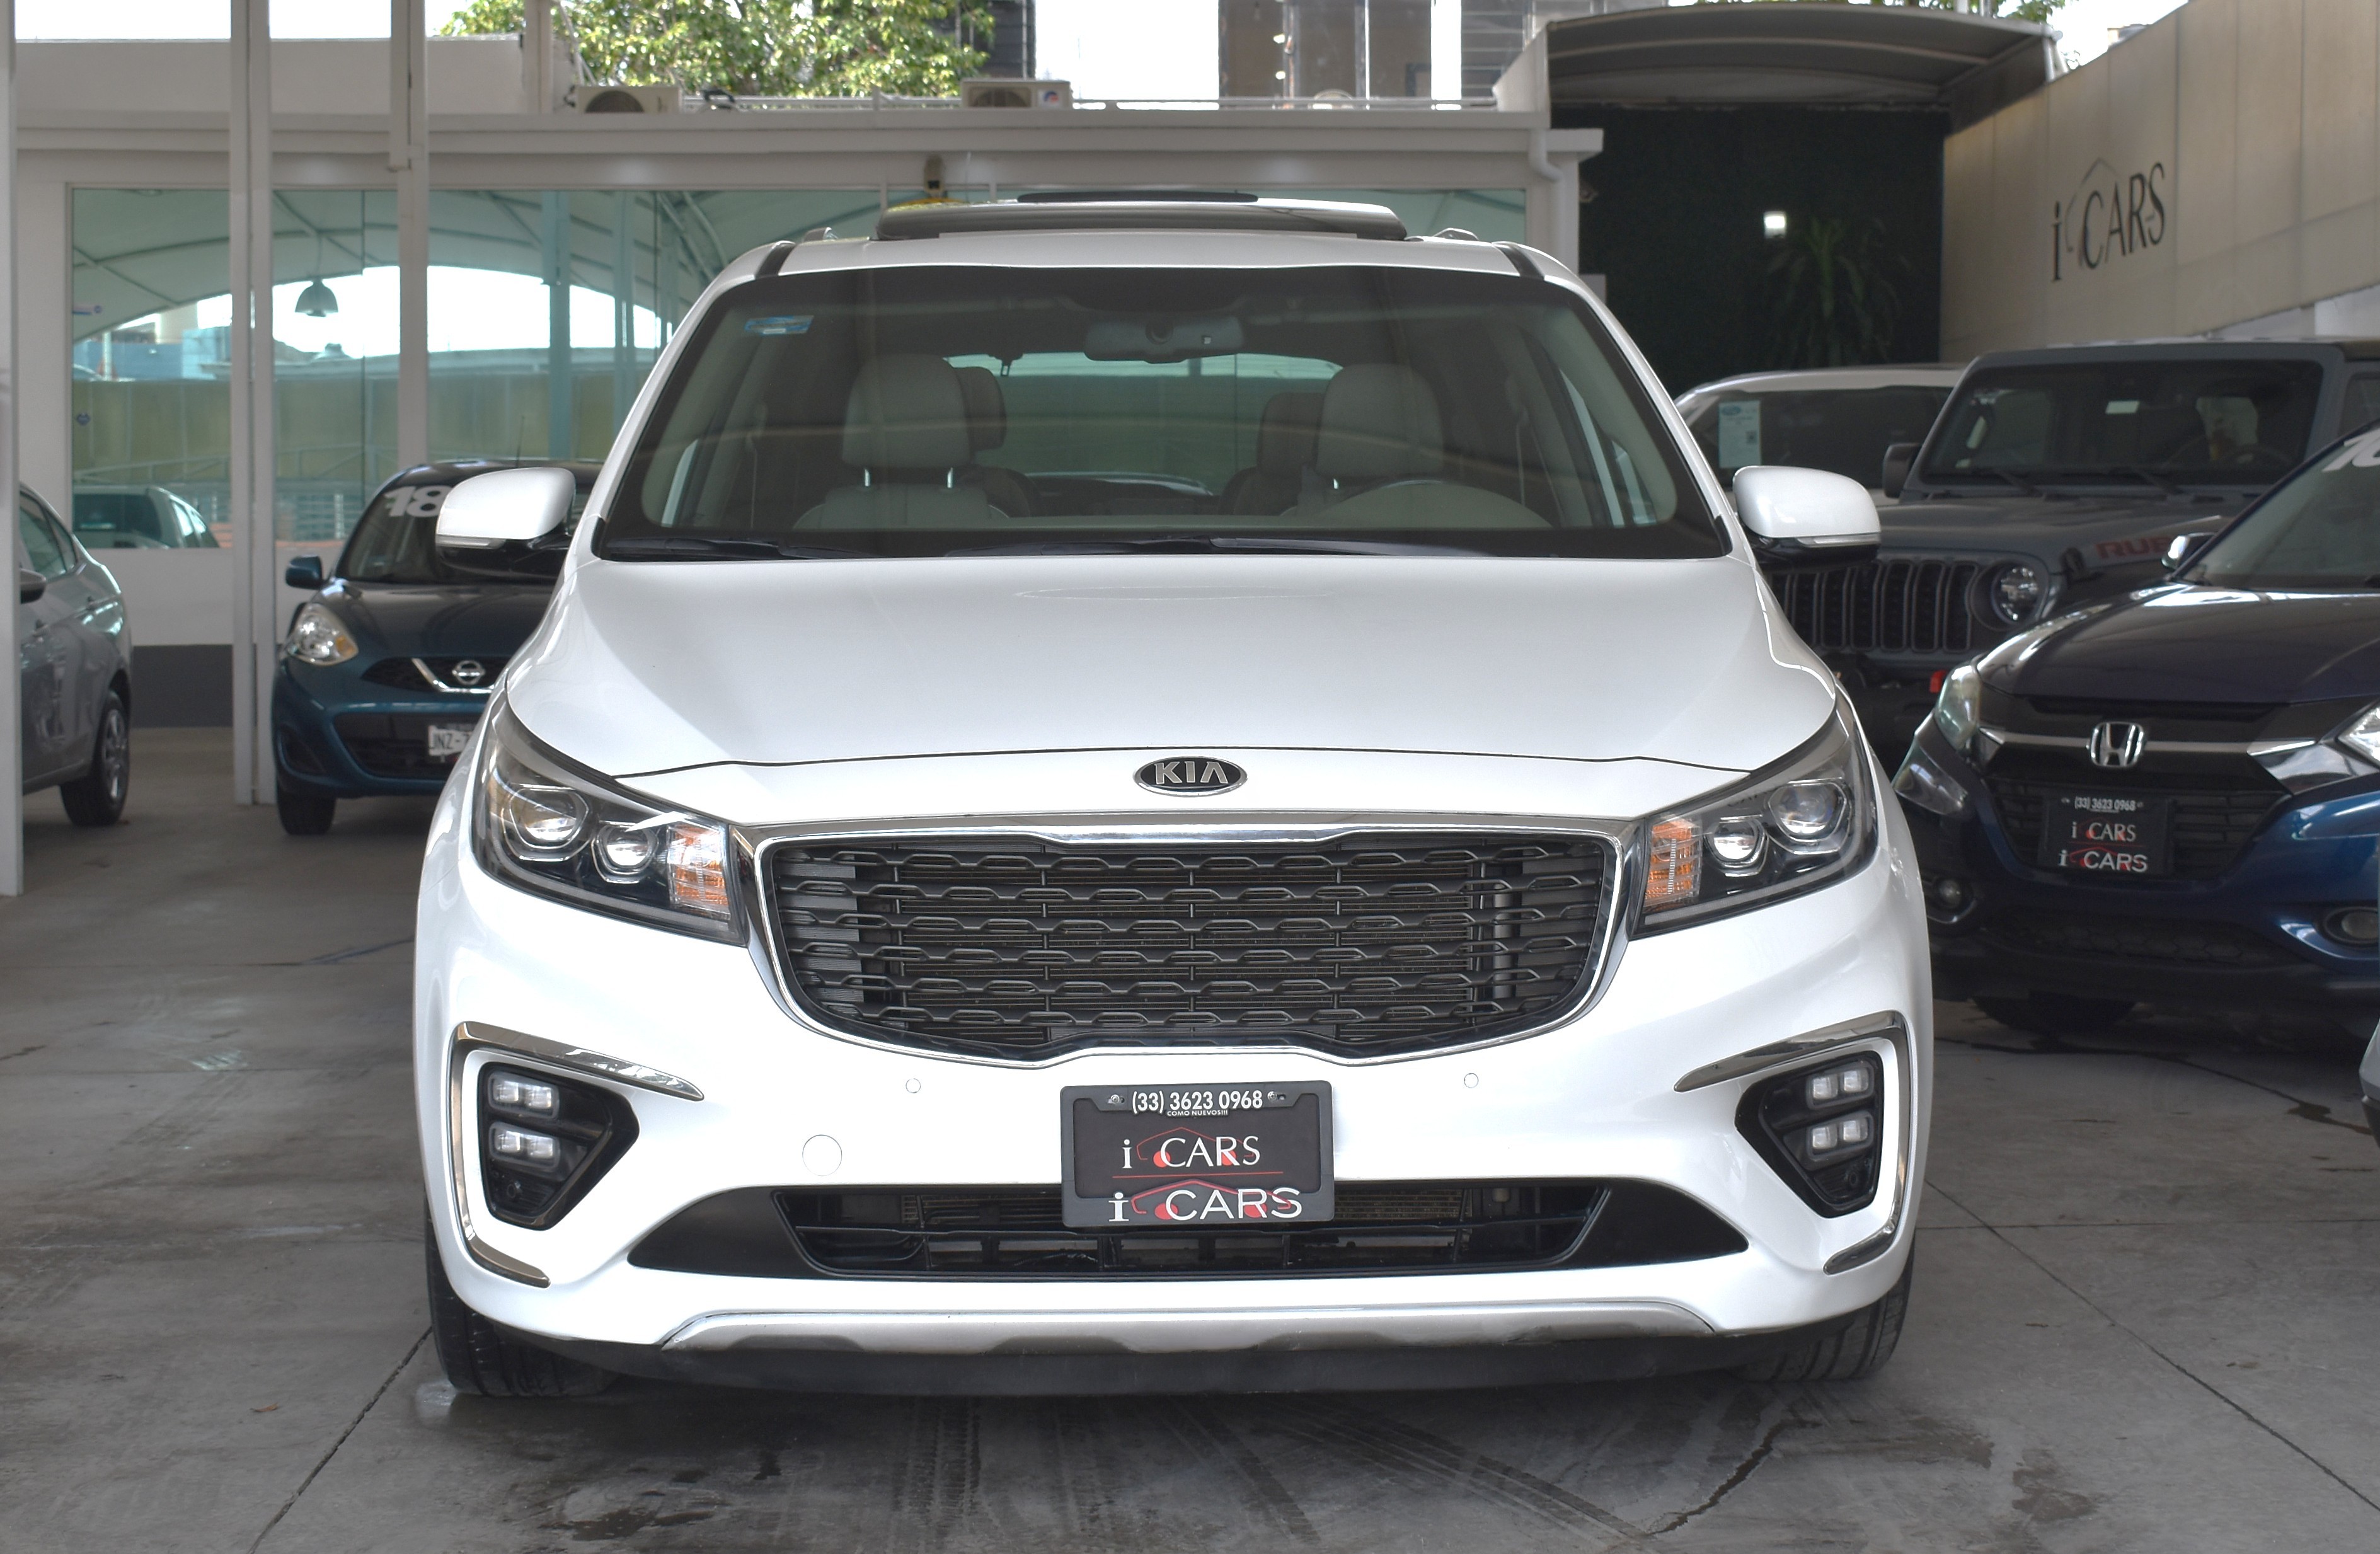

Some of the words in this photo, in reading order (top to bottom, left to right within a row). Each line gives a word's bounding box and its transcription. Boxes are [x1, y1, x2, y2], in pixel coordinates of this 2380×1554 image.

[2051, 200, 2061, 282] i
[2083, 161, 2165, 269] CARS
[383, 485, 453, 517] 18
[1154, 761, 1229, 785] KIA
[2074, 797, 2090, 810] (33)
[2091, 798, 2113, 809] 3623
[2114, 799, 2136, 812] 0968
[2071, 821, 2077, 839] i
[2088, 822, 2137, 842] CARS
[2058, 849, 2068, 867] i
[2083, 850, 2147, 872] CARS
[1132, 1090, 1164, 1114] (33)
[1170, 1091, 1214, 1110] 3623
[1219, 1090, 1263, 1110] 0968
[1122, 1139, 1132, 1169] i
[1161, 1136, 1260, 1167] CARS
[1108, 1192, 1130, 1222] i
[1166, 1187, 1302, 1221] CARS
